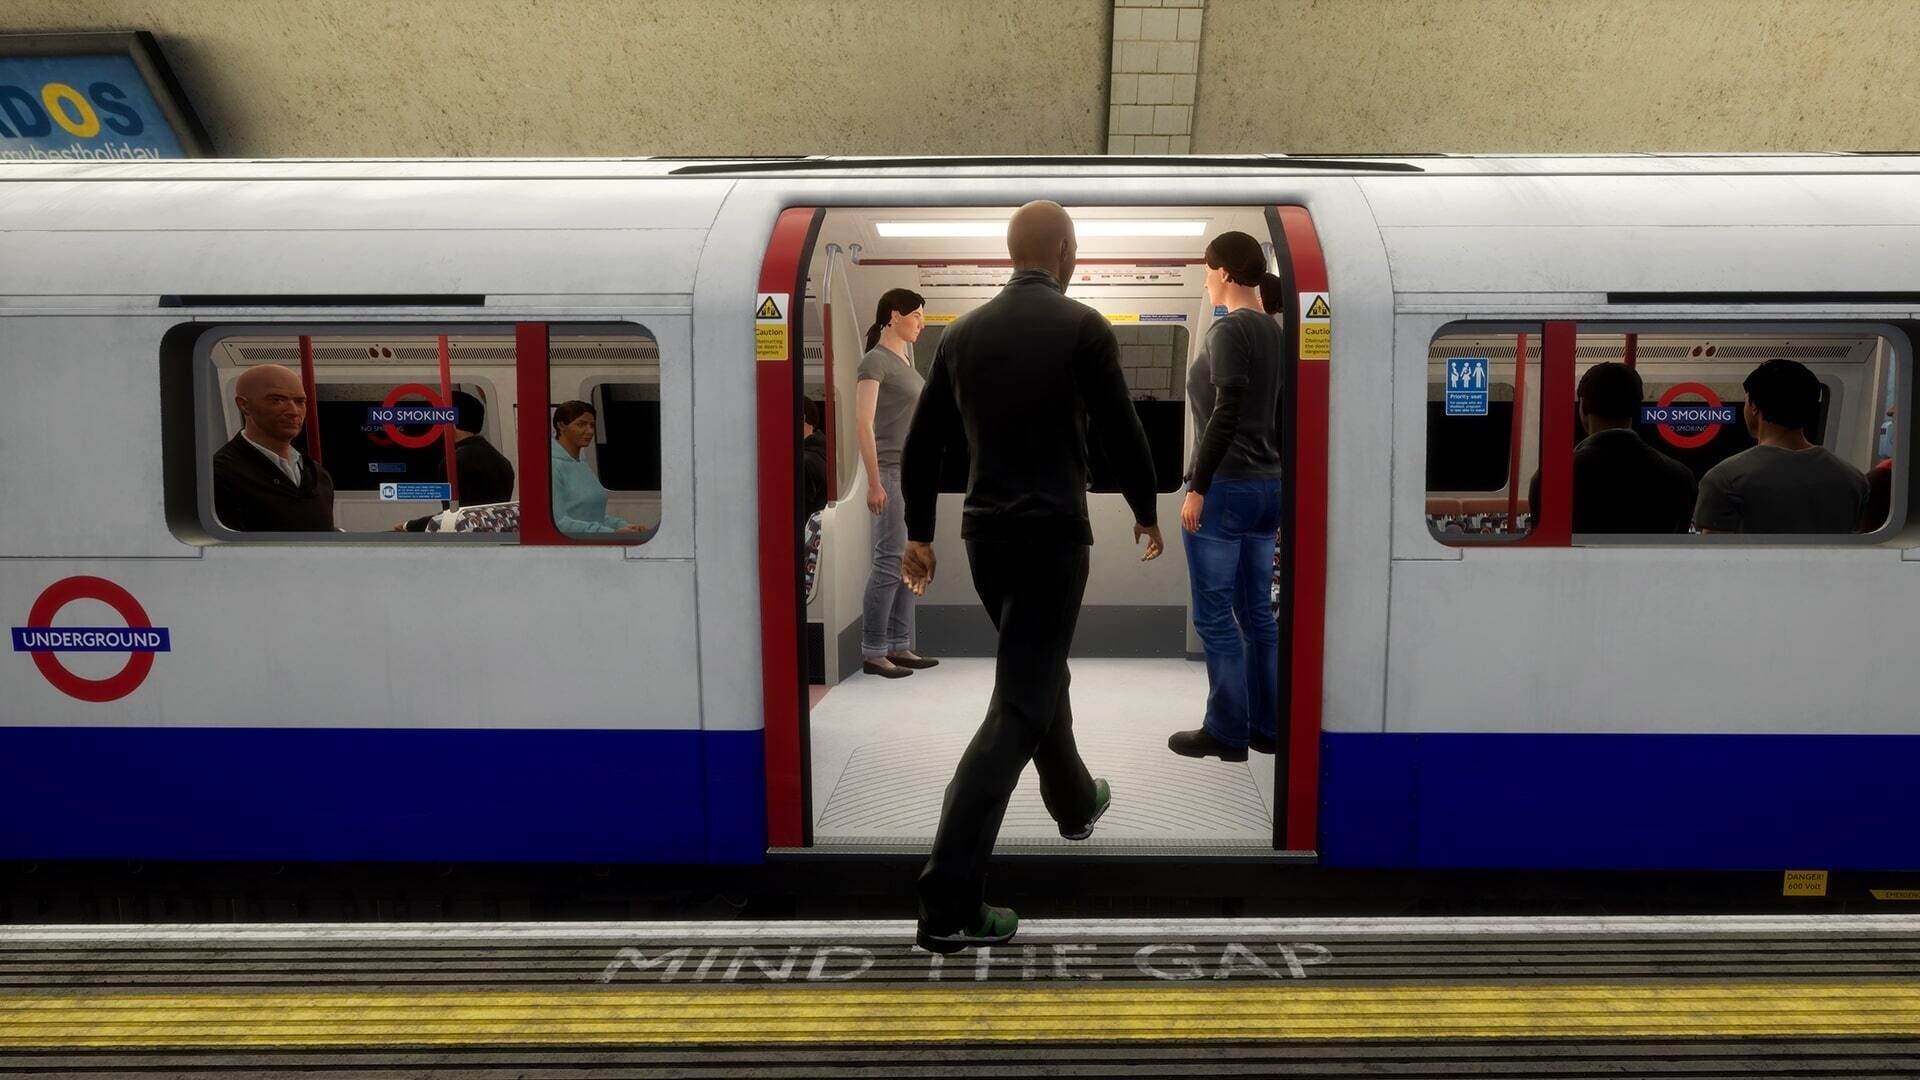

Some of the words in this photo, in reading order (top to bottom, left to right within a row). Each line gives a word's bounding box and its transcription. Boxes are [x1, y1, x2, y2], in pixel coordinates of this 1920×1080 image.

[372, 411, 393, 421] NO
[397, 410, 455, 421] SMOKING
[1646, 410, 1668, 421] NO
[1671, 410, 1732, 421] SMOKING
[22, 632, 161, 647] UNDERGROUND
[1787, 873, 1825, 881] DANGER!
[598, 946, 876, 983] MIND
[911, 943, 1104, 982] THE
[1133, 943, 1333, 980] GAP
